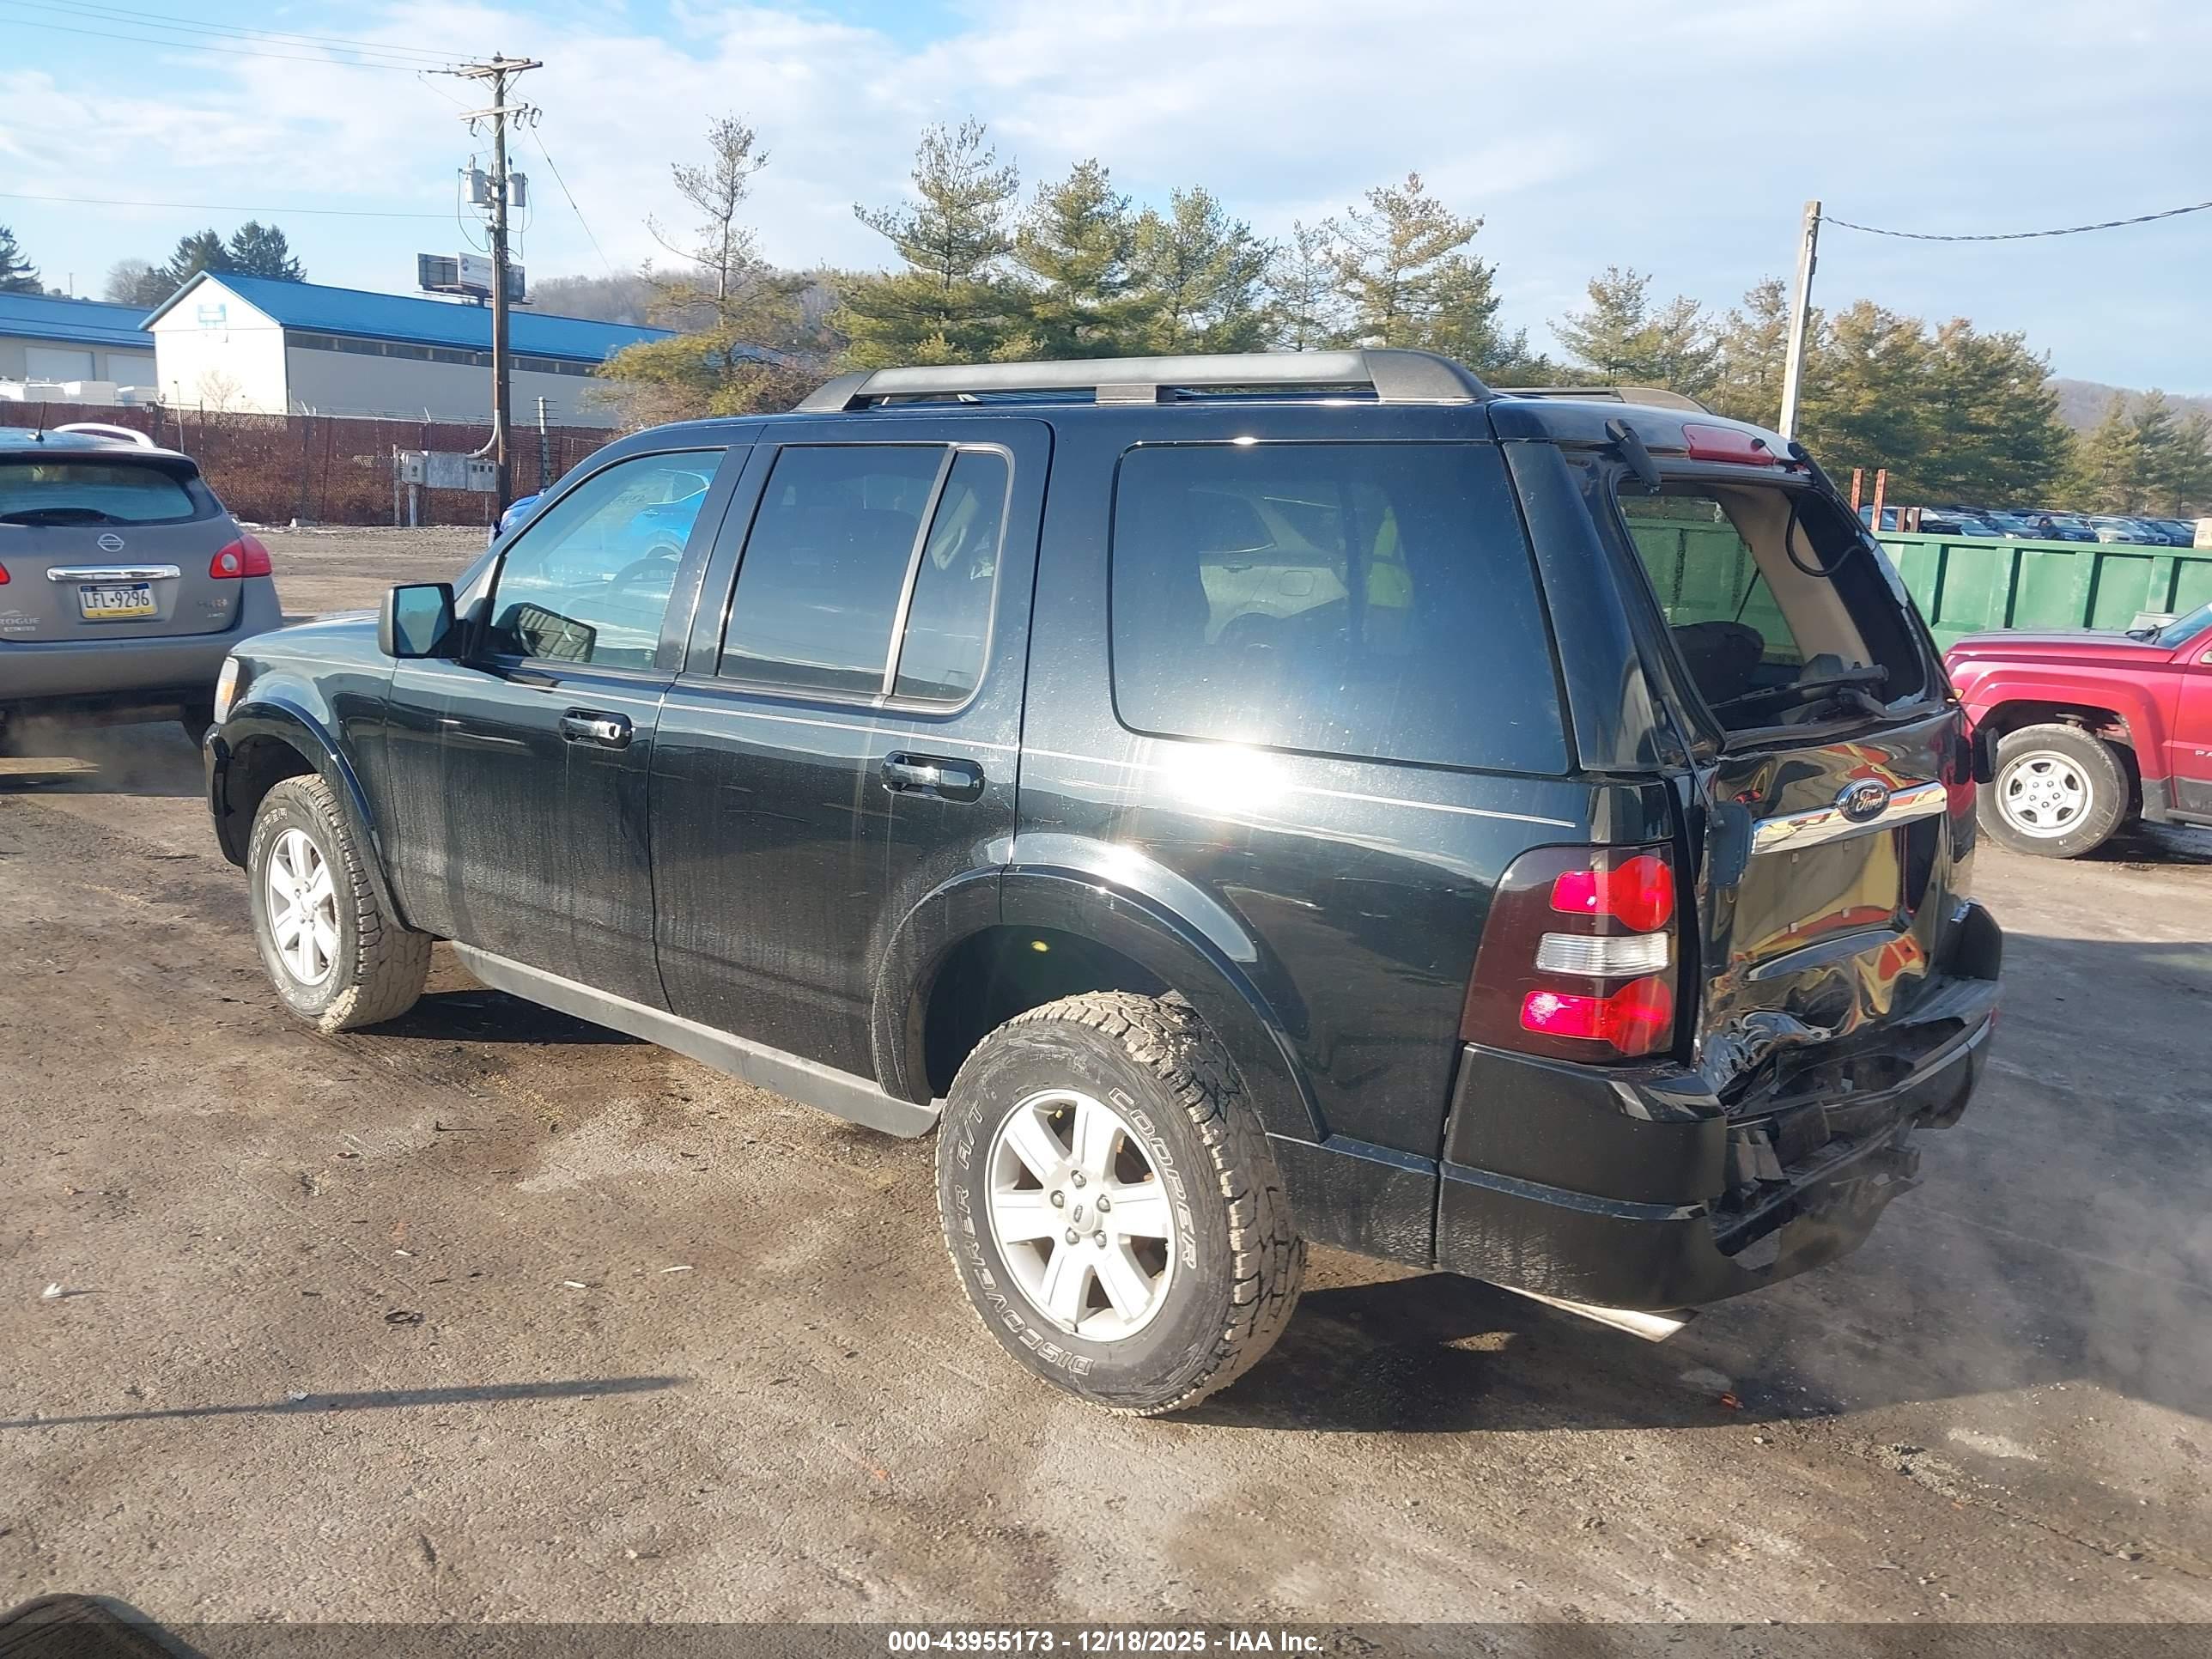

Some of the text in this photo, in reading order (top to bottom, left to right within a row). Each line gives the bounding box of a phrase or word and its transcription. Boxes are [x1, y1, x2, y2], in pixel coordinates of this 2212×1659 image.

[250, 807, 289, 872] COOPER
[1856, 787, 1885, 812] Ford
[956, 1099, 1094, 1376] DISCOVERER A/T
[1109, 1086, 1198, 1270] COOPER
